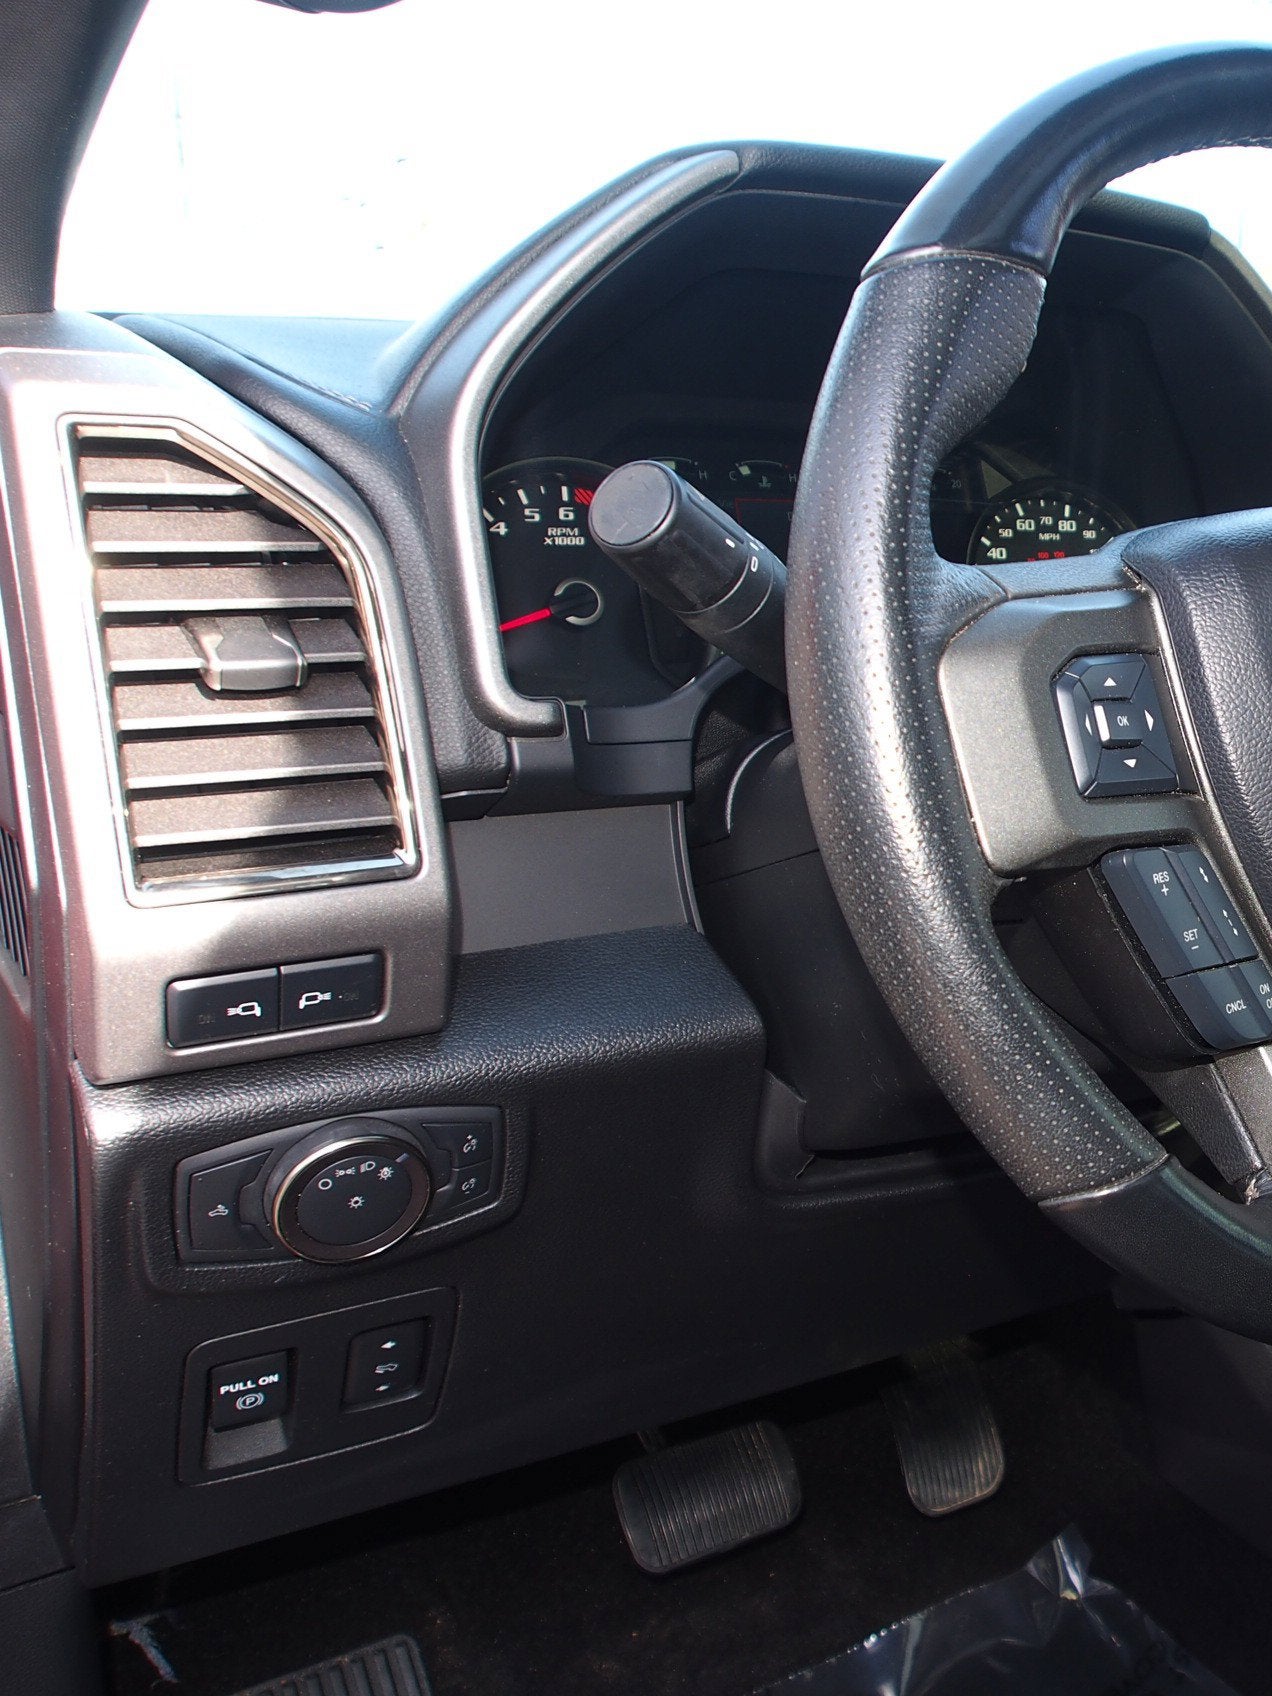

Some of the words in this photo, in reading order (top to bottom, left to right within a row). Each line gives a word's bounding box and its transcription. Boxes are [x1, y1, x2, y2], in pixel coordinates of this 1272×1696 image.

[524, 508, 540, 522] 5
[558, 507, 574, 520] 6
[1016, 518, 1035, 531] 60
[1039, 515, 1053, 526] 70
[1057, 519, 1077, 532] 80
[489, 521, 508, 536] 4
[547, 526, 579, 536] RPM
[998, 527, 1013, 538] 50
[1082, 529, 1096, 539] 90
[1038, 532, 1061, 541] MPH
[987, 547, 1007, 560] 40
[1116, 715, 1129, 727] OK
[1152, 870, 1170, 884] RES
[1183, 928, 1199, 943] SET
[1259, 982, 1270, 995] ON
[1225, 1000, 1247, 1015] CNCL
[220, 1380, 256, 1395] PULL
[258, 1373, 279, 1385] ON
